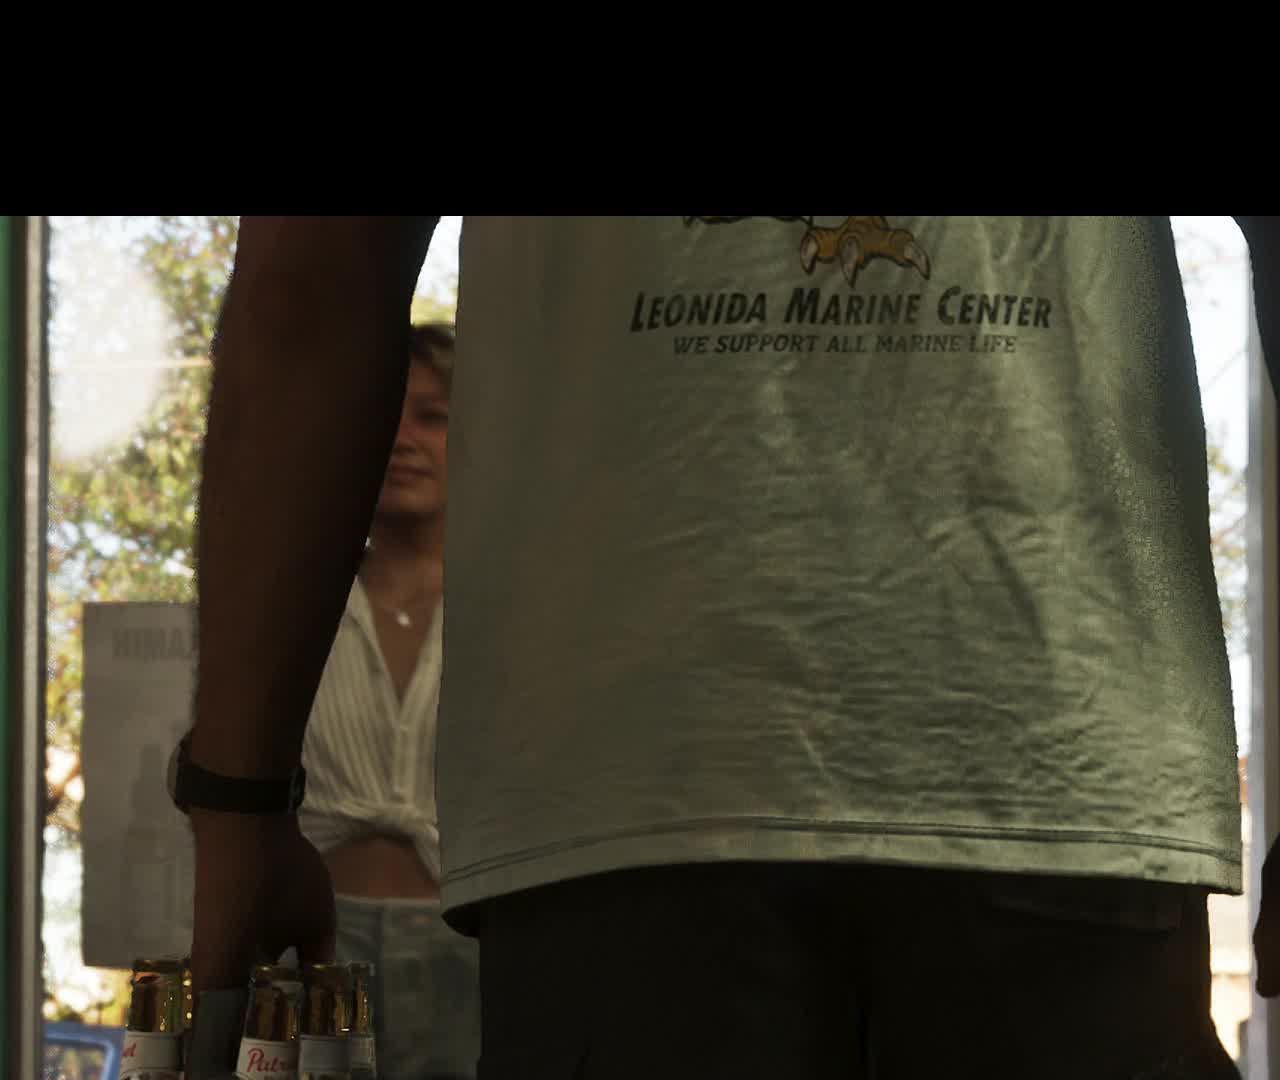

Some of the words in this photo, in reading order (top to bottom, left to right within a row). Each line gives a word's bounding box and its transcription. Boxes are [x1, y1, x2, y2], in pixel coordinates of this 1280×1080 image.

[630, 290, 768, 332] LEONIDA
[783, 287, 921, 326] MARINE
[937, 286, 1053, 328] CENTER
[673, 335, 708, 355] WE
[715, 334, 818, 354] SUPPORT
[826, 334, 867, 353] ALL
[875, 334, 961, 353] MARINE
[968, 334, 1018, 353] LIFE
